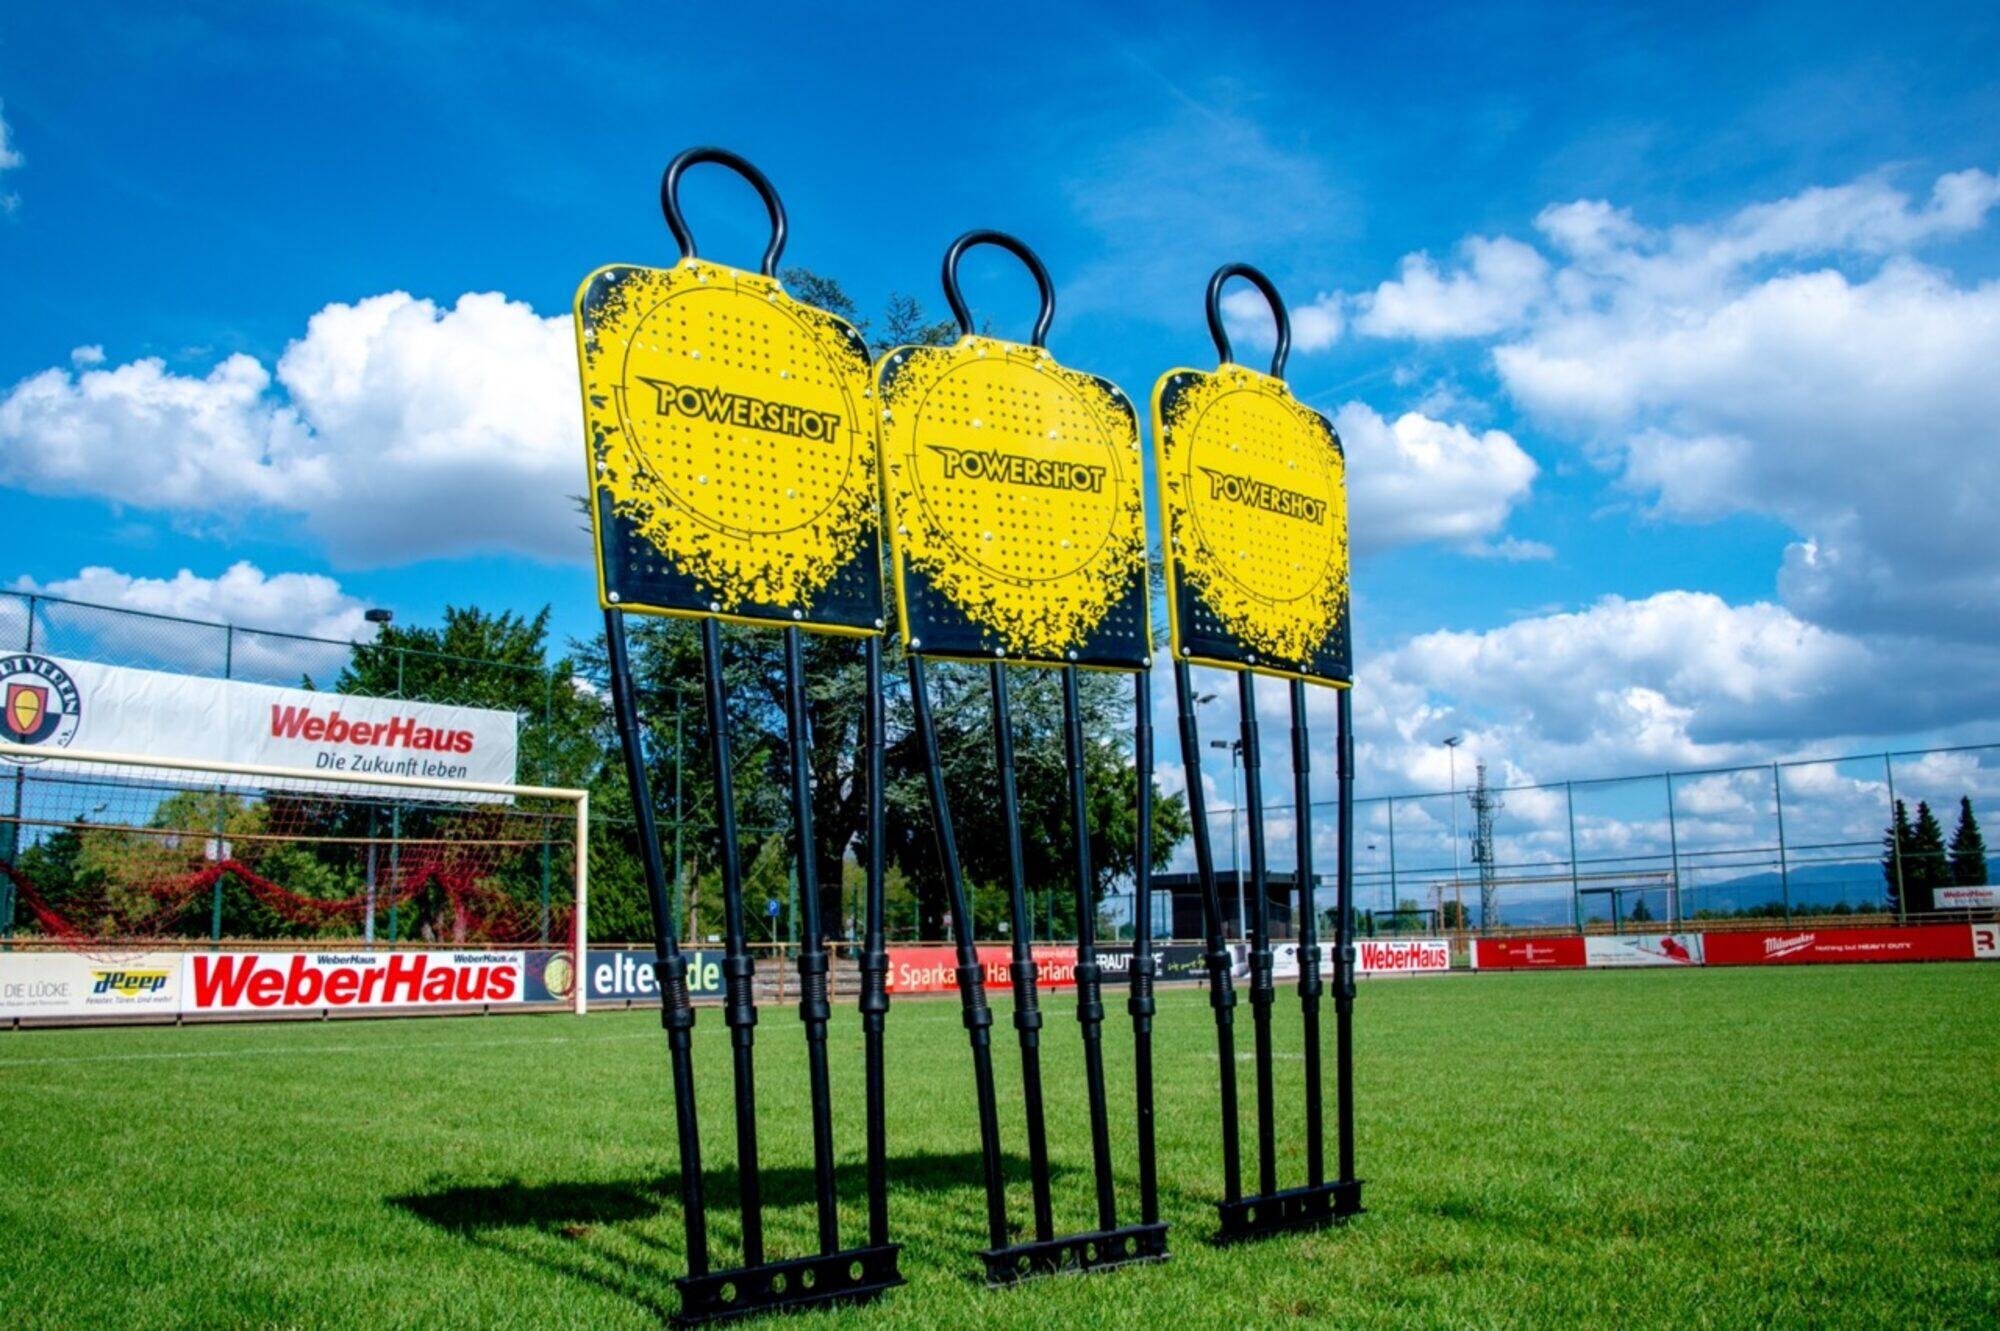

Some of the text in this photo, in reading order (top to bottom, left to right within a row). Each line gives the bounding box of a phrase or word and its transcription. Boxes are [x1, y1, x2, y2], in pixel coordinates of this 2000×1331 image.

[635, 376, 840, 444] POWERSHOT
[925, 444, 1106, 493] POWERSHOT
[1196, 465, 1327, 525] POWERSHOT
[271, 704, 474, 754] WeberHaus
[316, 752, 467, 779] Die Zukunft leben
[317, 955, 376, 964] WeberHaus
[901, 961, 957, 990] Sparka
[1361, 943, 1446, 969] WeberHaus
[4, 983, 24, 998] DIE
[193, 954, 517, 1008] WeberHaus
